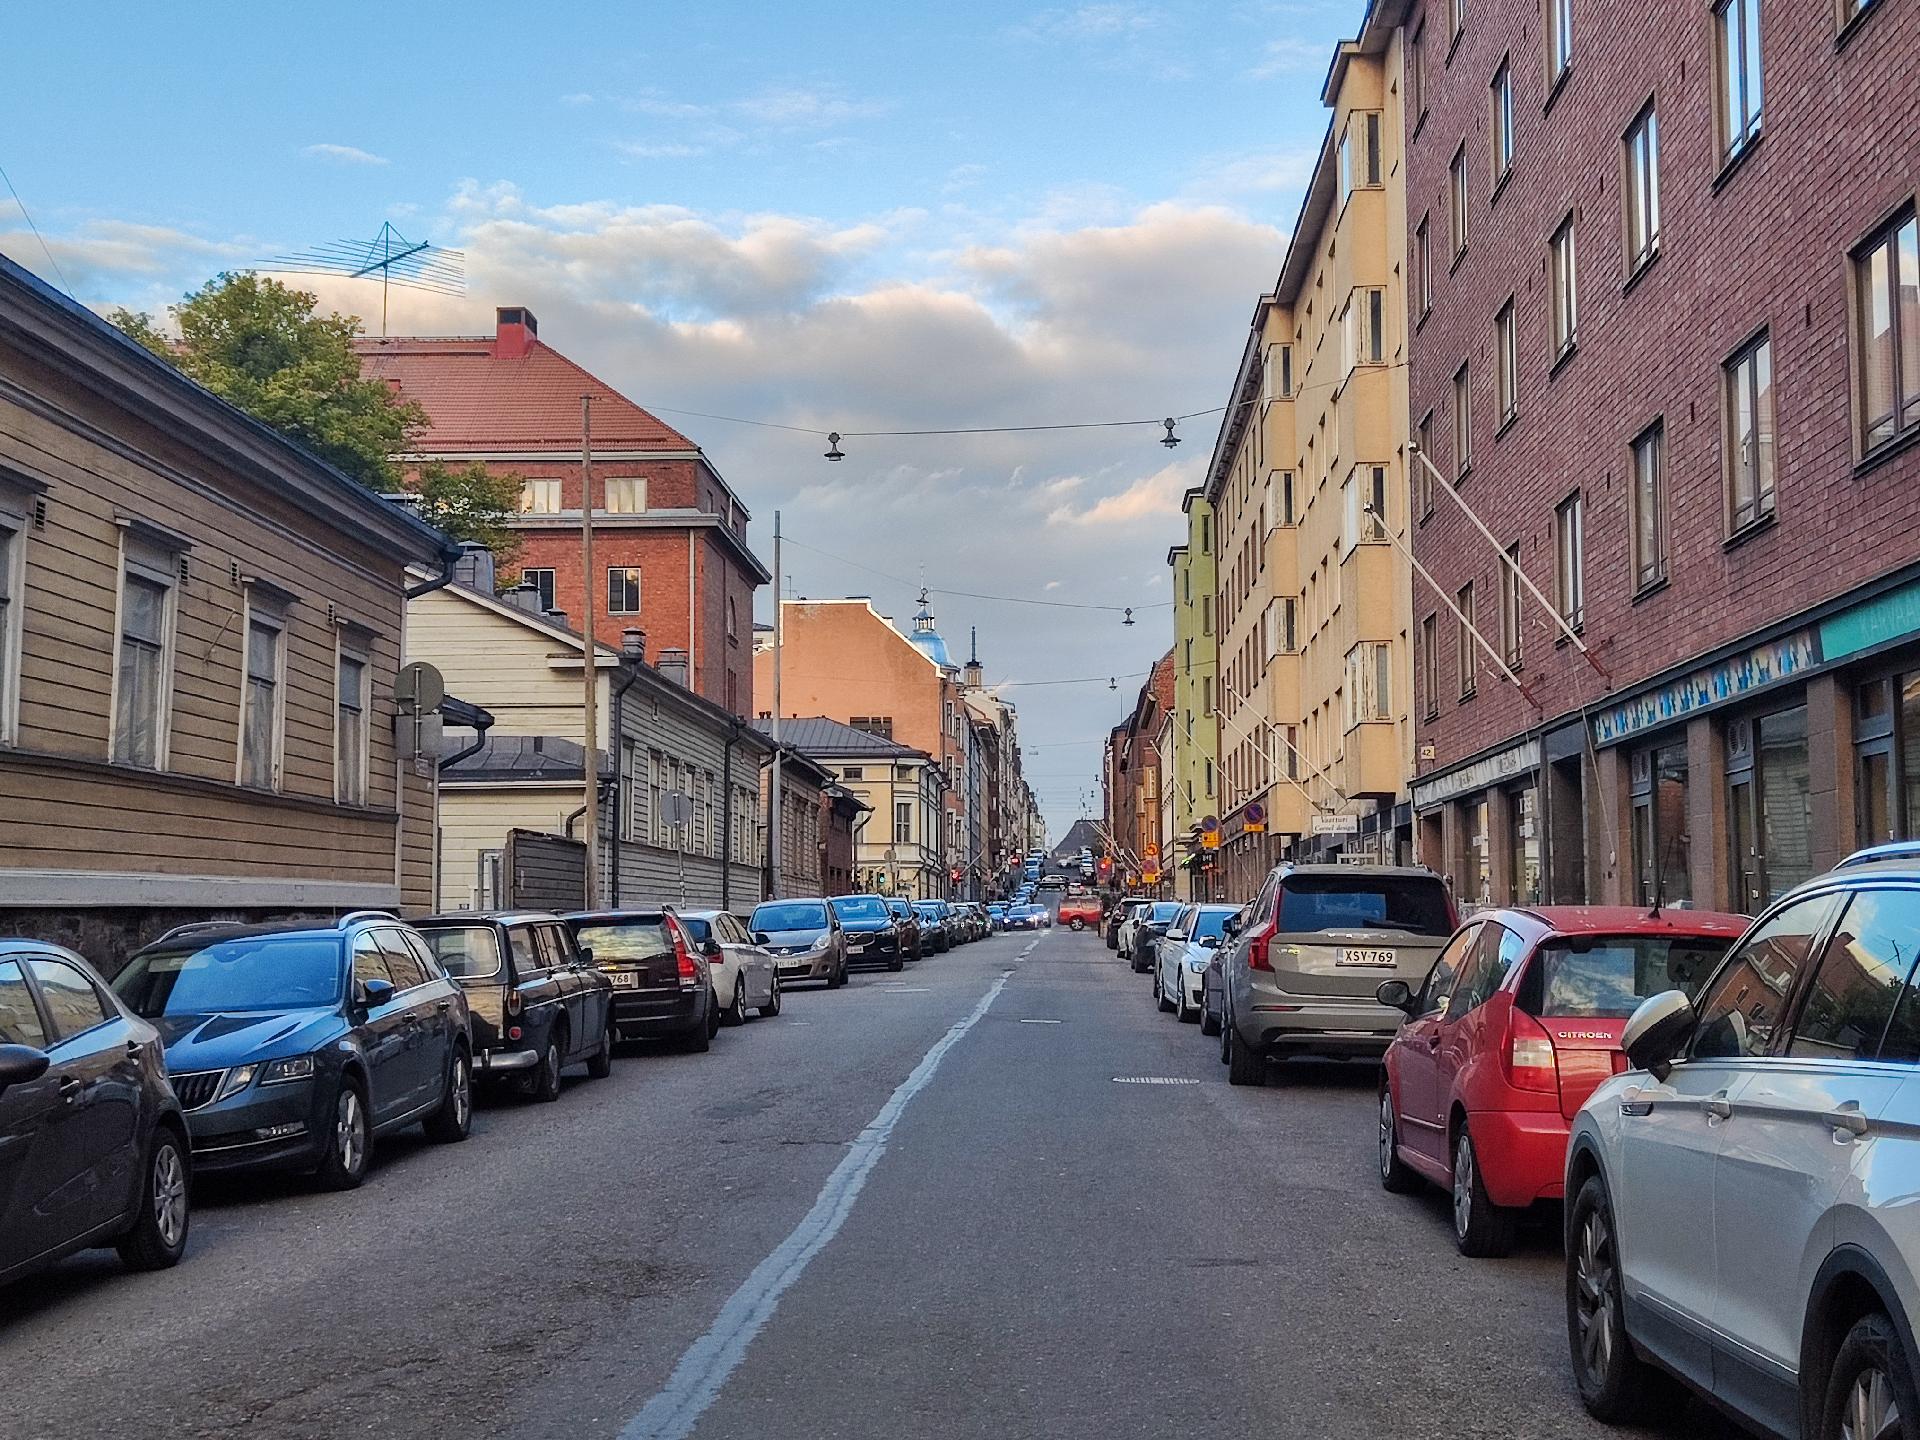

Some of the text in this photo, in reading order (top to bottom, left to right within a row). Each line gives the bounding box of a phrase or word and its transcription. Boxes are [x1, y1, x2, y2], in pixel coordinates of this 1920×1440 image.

[1422, 749, 1431, 757] 42
[1345, 950, 1393, 962] XSY-769
[610, 974, 629, 983] 768
